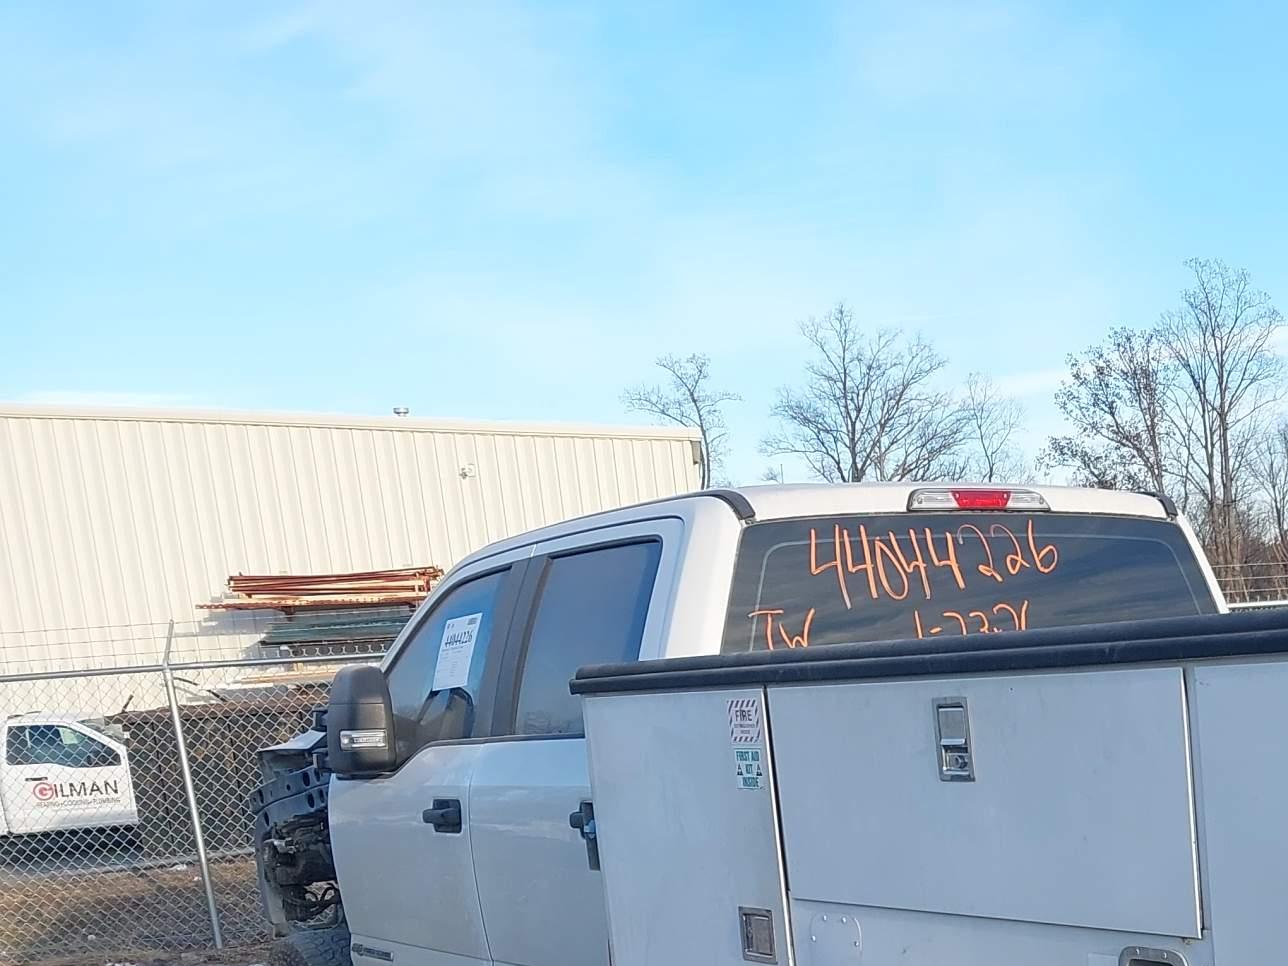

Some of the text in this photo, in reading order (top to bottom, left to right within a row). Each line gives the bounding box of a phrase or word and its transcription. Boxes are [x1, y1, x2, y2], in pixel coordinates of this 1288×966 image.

[808, 519, 1059, 610] 44044226
[747, 608, 816, 650] TW
[735, 709, 753, 722] FIRE
[33, 780, 119, 801] GILMAN
